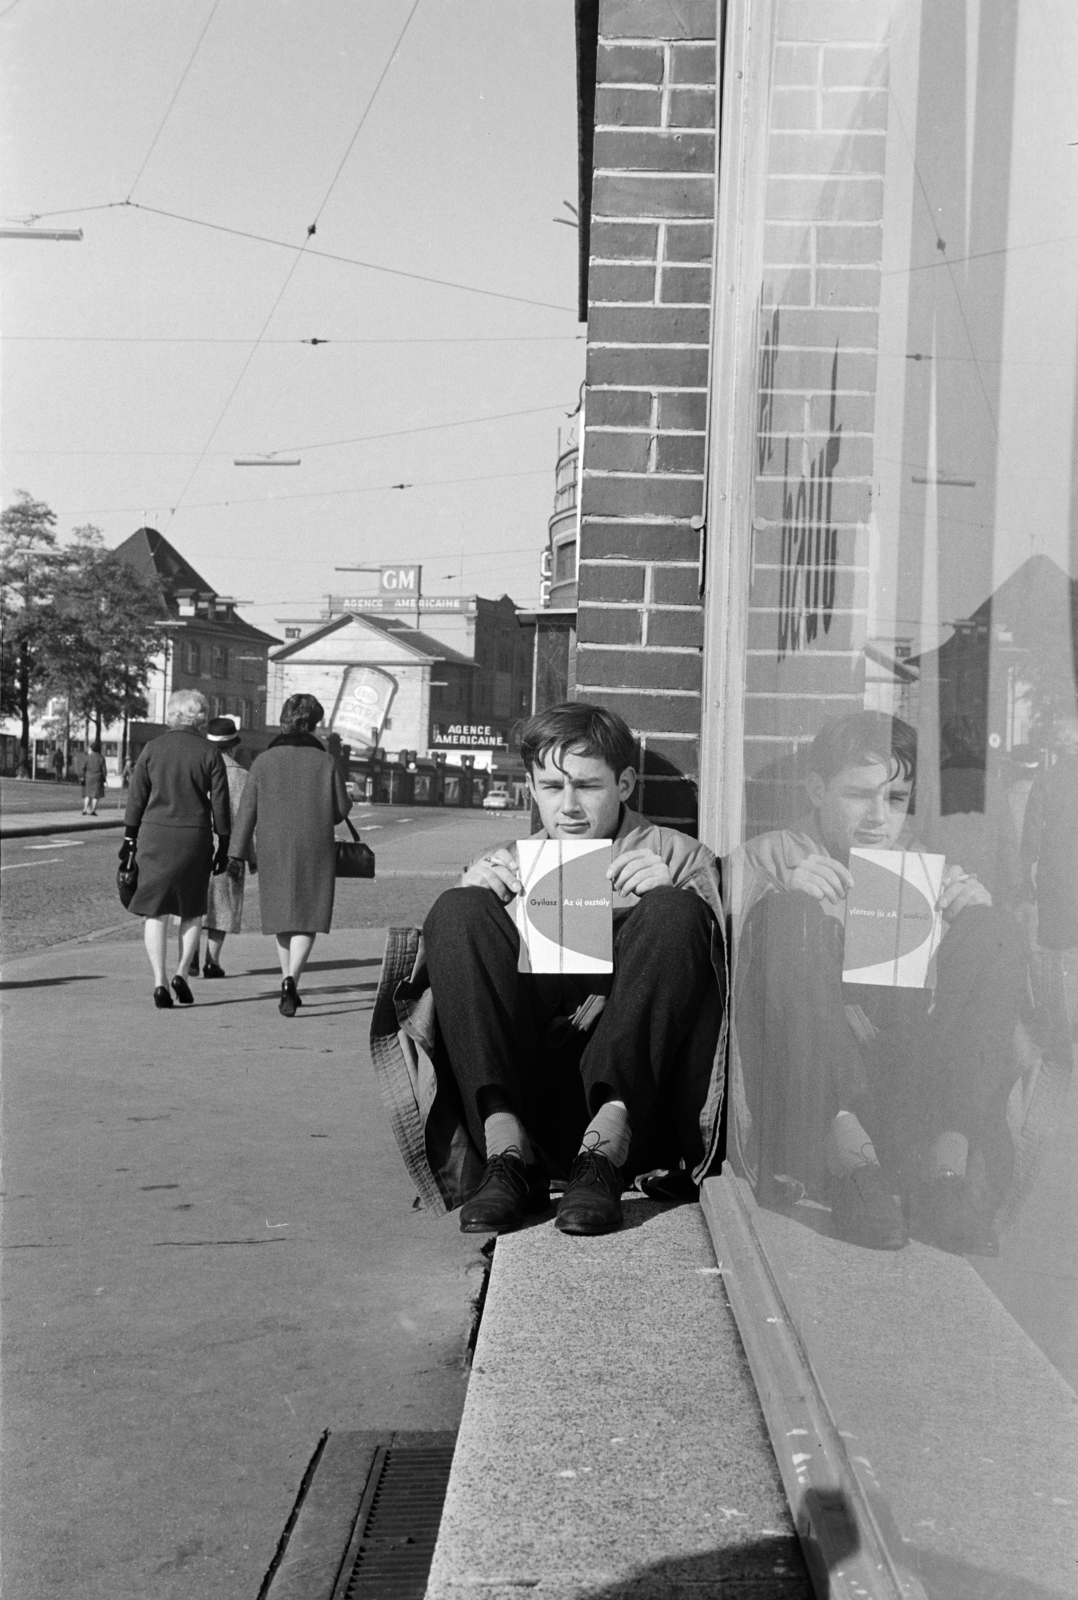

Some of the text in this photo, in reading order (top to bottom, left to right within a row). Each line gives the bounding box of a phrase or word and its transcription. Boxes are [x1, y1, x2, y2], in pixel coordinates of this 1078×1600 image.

[382, 570, 415, 590] GM
[343, 599, 460, 608] AGENCE AMERICAINE
[341, 701, 378, 724] EXTRA
[338, 715, 363, 727] MOTOR
[448, 724, 491, 735] AGENCE
[435, 734, 503, 746] AMERICAINE
[530, 898, 610, 907] Gyilasz Az új osztály
